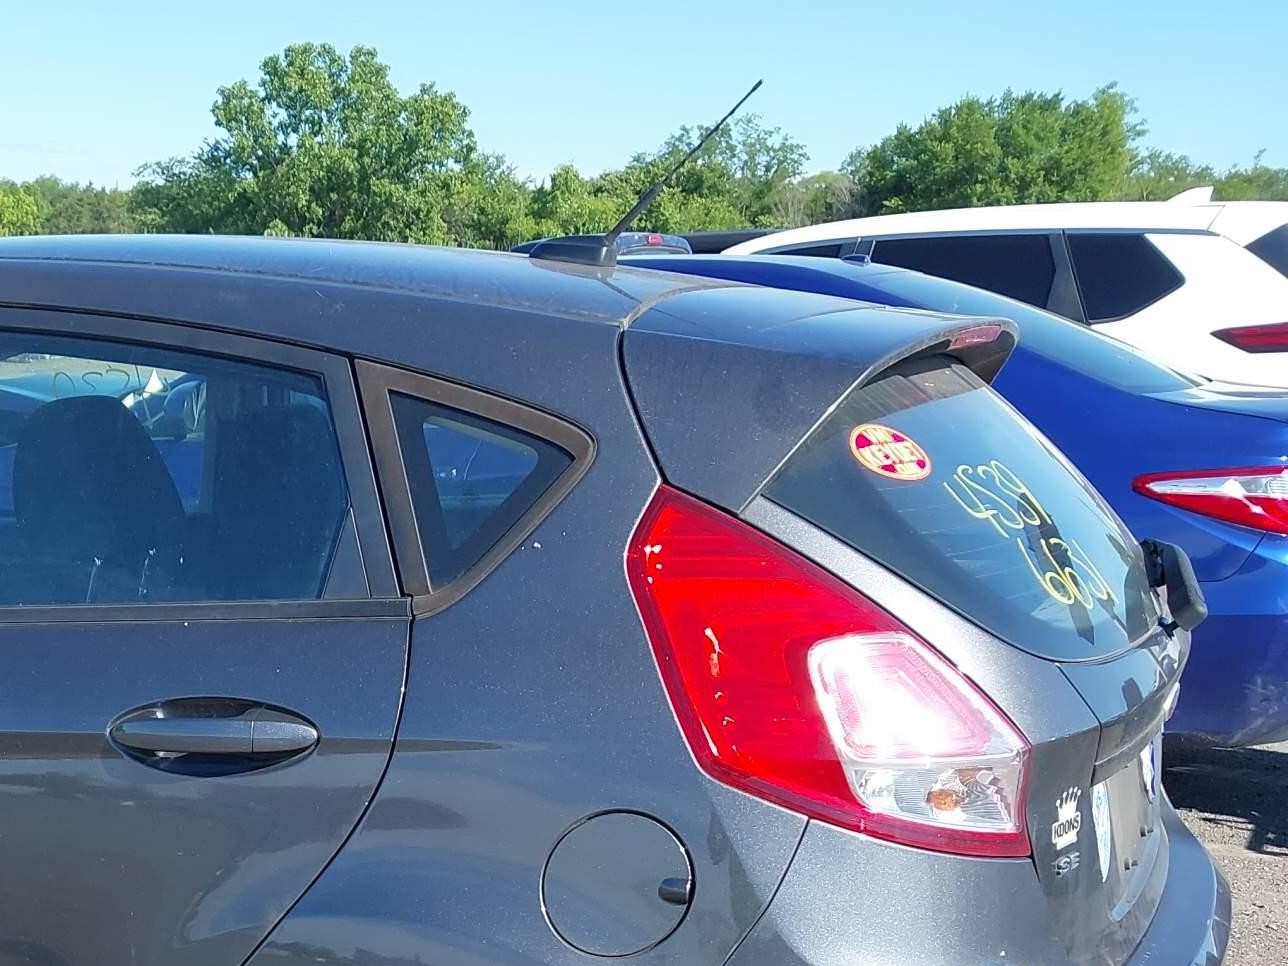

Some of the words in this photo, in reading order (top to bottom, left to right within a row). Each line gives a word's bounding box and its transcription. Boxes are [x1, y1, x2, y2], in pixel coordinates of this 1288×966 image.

[944, 460, 1051, 539] 4539
[1016, 537, 1120, 609] 6631
[1053, 817, 1080, 839] KOONS
